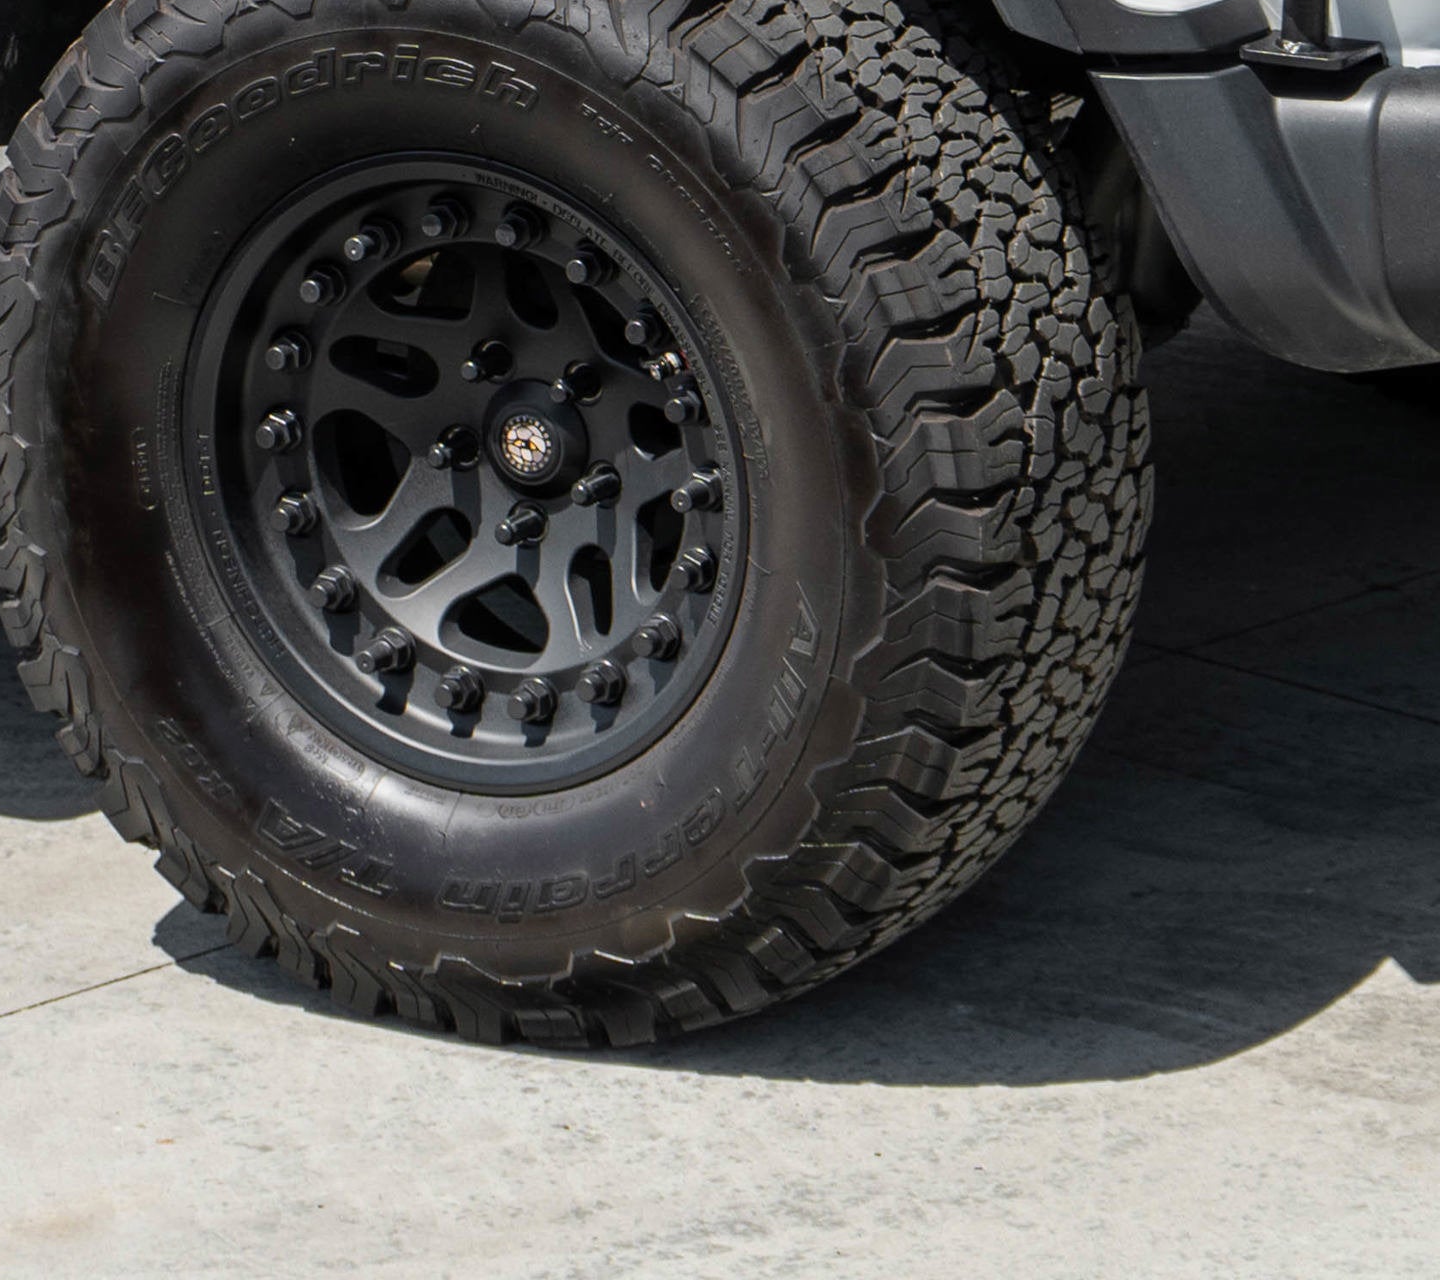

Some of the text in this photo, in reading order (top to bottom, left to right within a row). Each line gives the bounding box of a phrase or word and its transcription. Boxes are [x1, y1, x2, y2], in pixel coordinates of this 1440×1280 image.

[82, 43, 542, 302] BFGoodrich
[252, 797, 404, 902] T/A
[439, 580, 820, 924] All-Terrain
